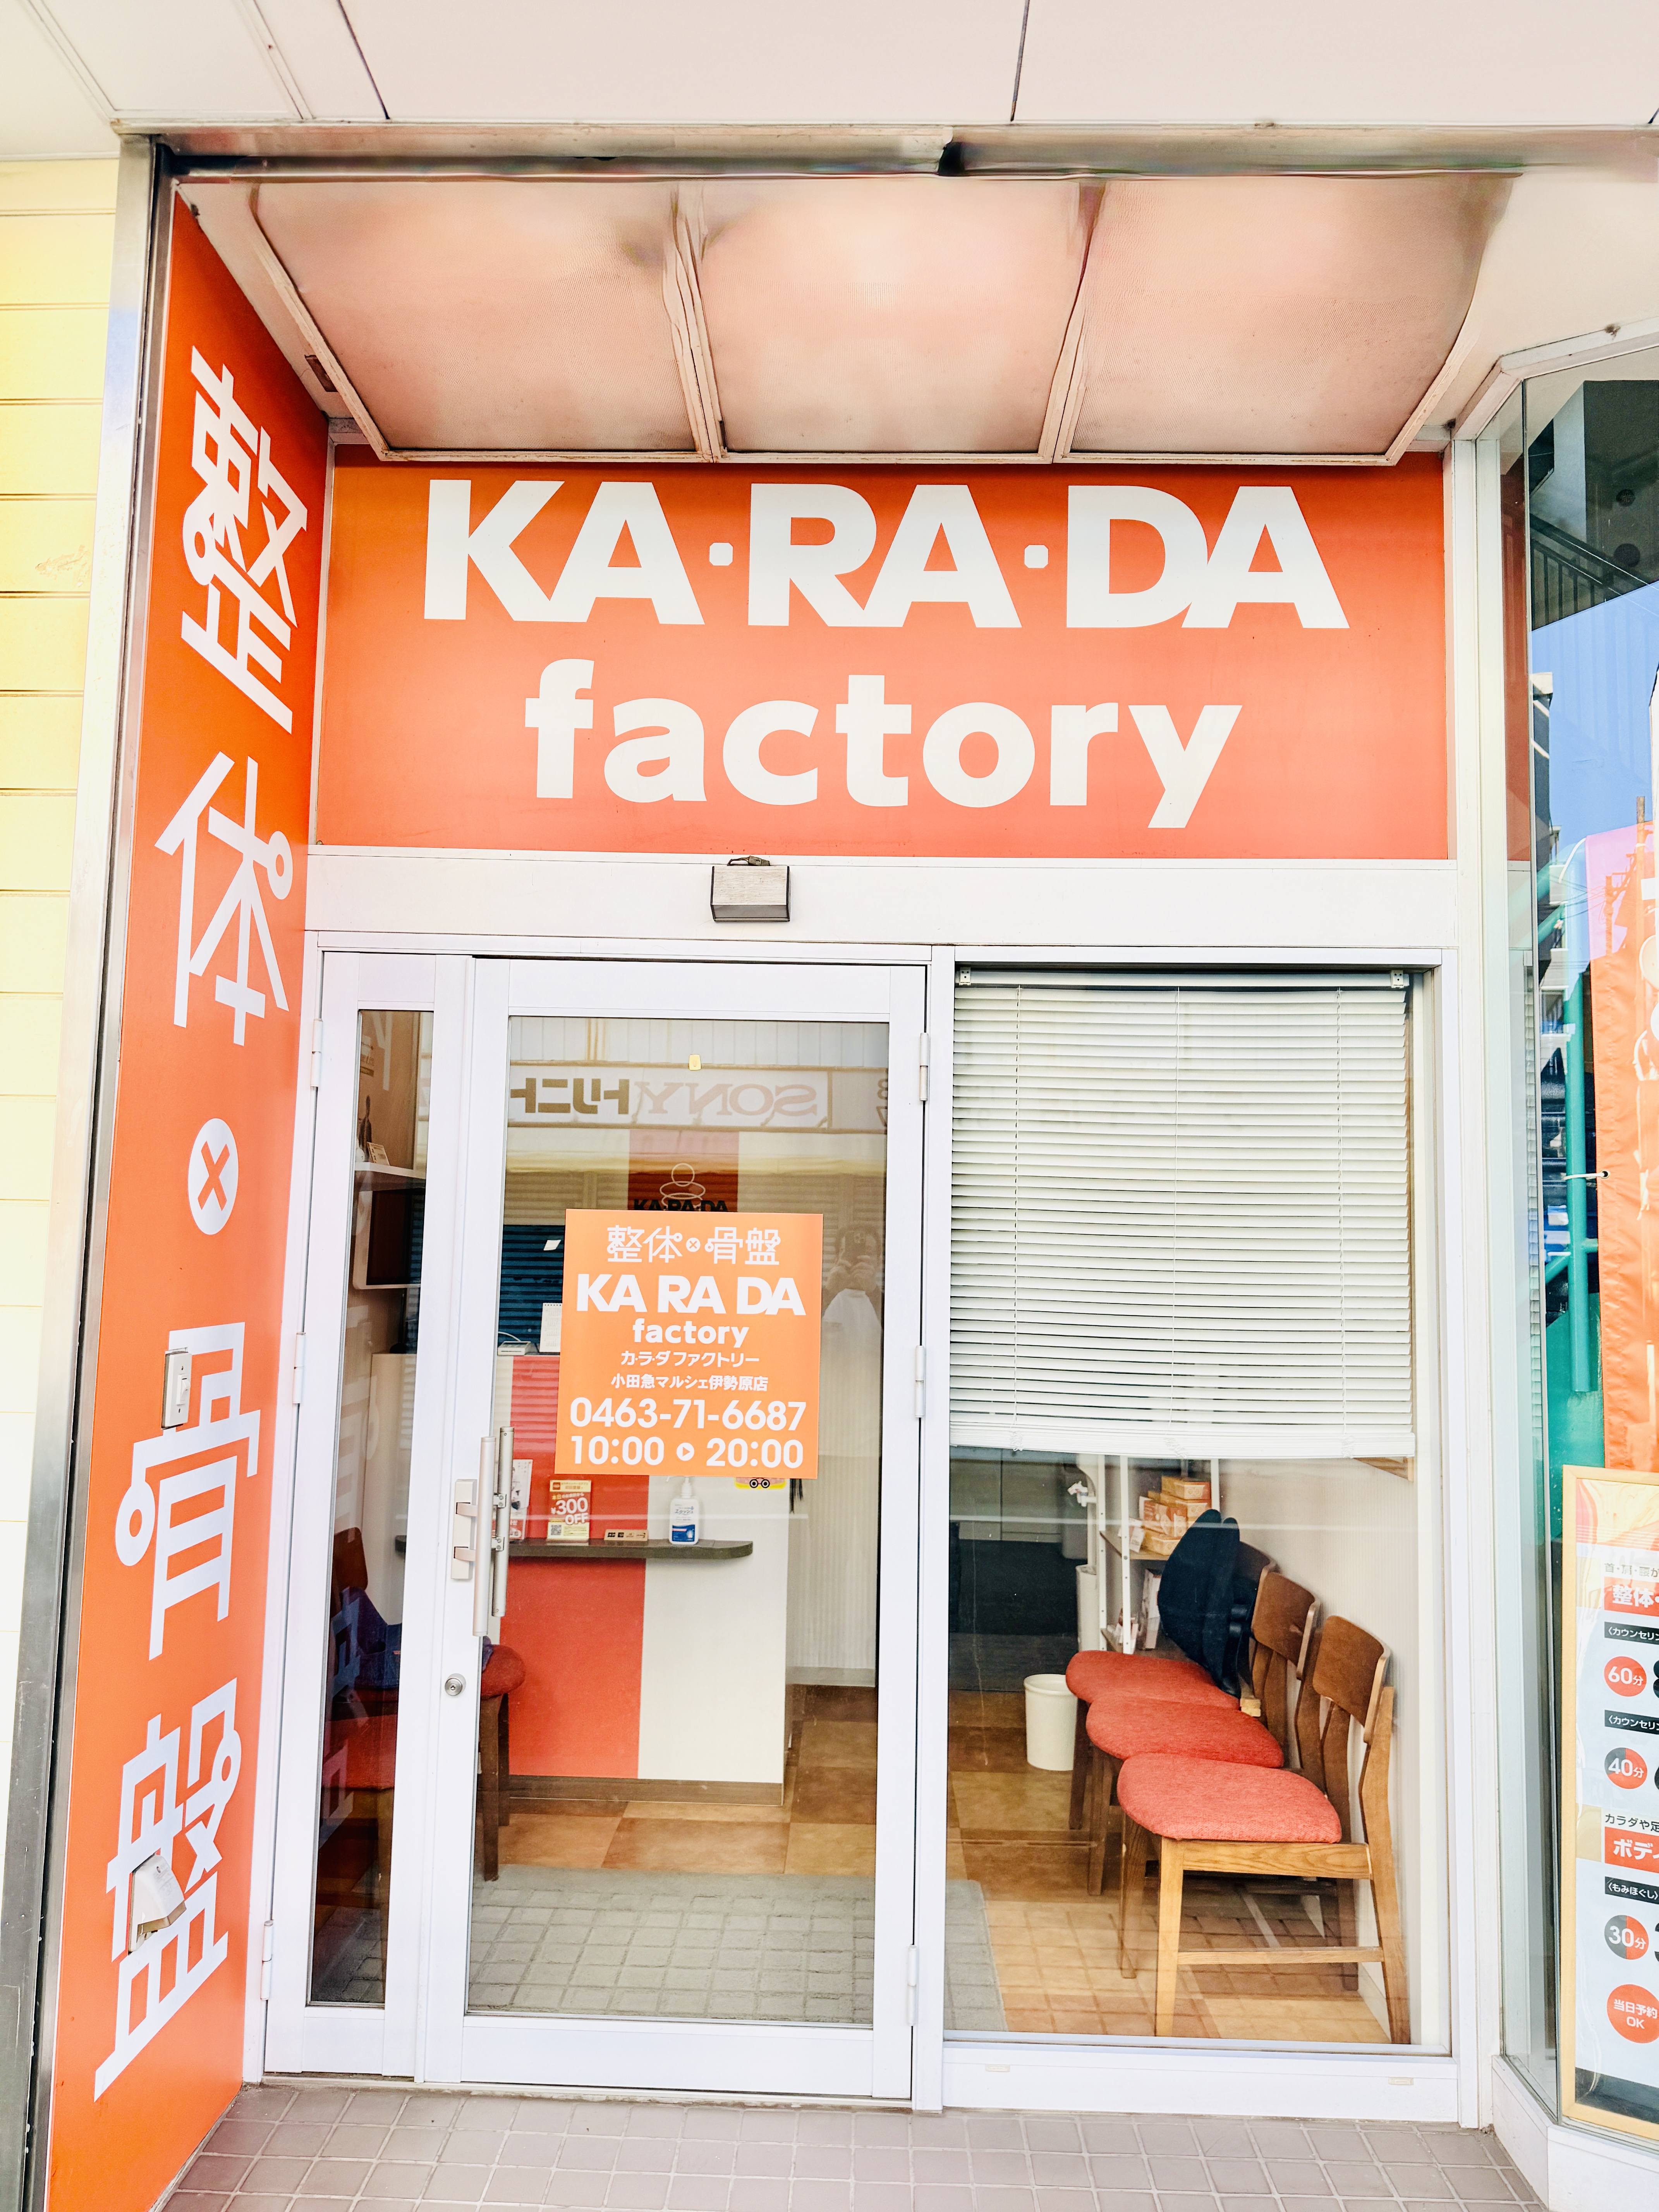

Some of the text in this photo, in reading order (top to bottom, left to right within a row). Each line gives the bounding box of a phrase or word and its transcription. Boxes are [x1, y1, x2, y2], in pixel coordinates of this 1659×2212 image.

[525, 659, 1242, 829] factory
[577, 1274, 806, 1316] KA RA DA
[632, 1318, 749, 1348] factory
[611, 1373, 768, 1391] 小田急マルシェ伊勢原店
[570, 1397, 806, 1431] 0463-71-6687
[571, 1436, 804, 1468] 10:00 20:00
[565, 1512, 589, 1525] OFF
[1608, 1666, 1644, 1686] 60分
[1608, 1758, 1644, 1778] 40分
[1608, 1925, 1646, 1949] 30分
[1613, 1999, 1658, 2019] 当日予約
[1626, 2016, 1645, 2029] OK
